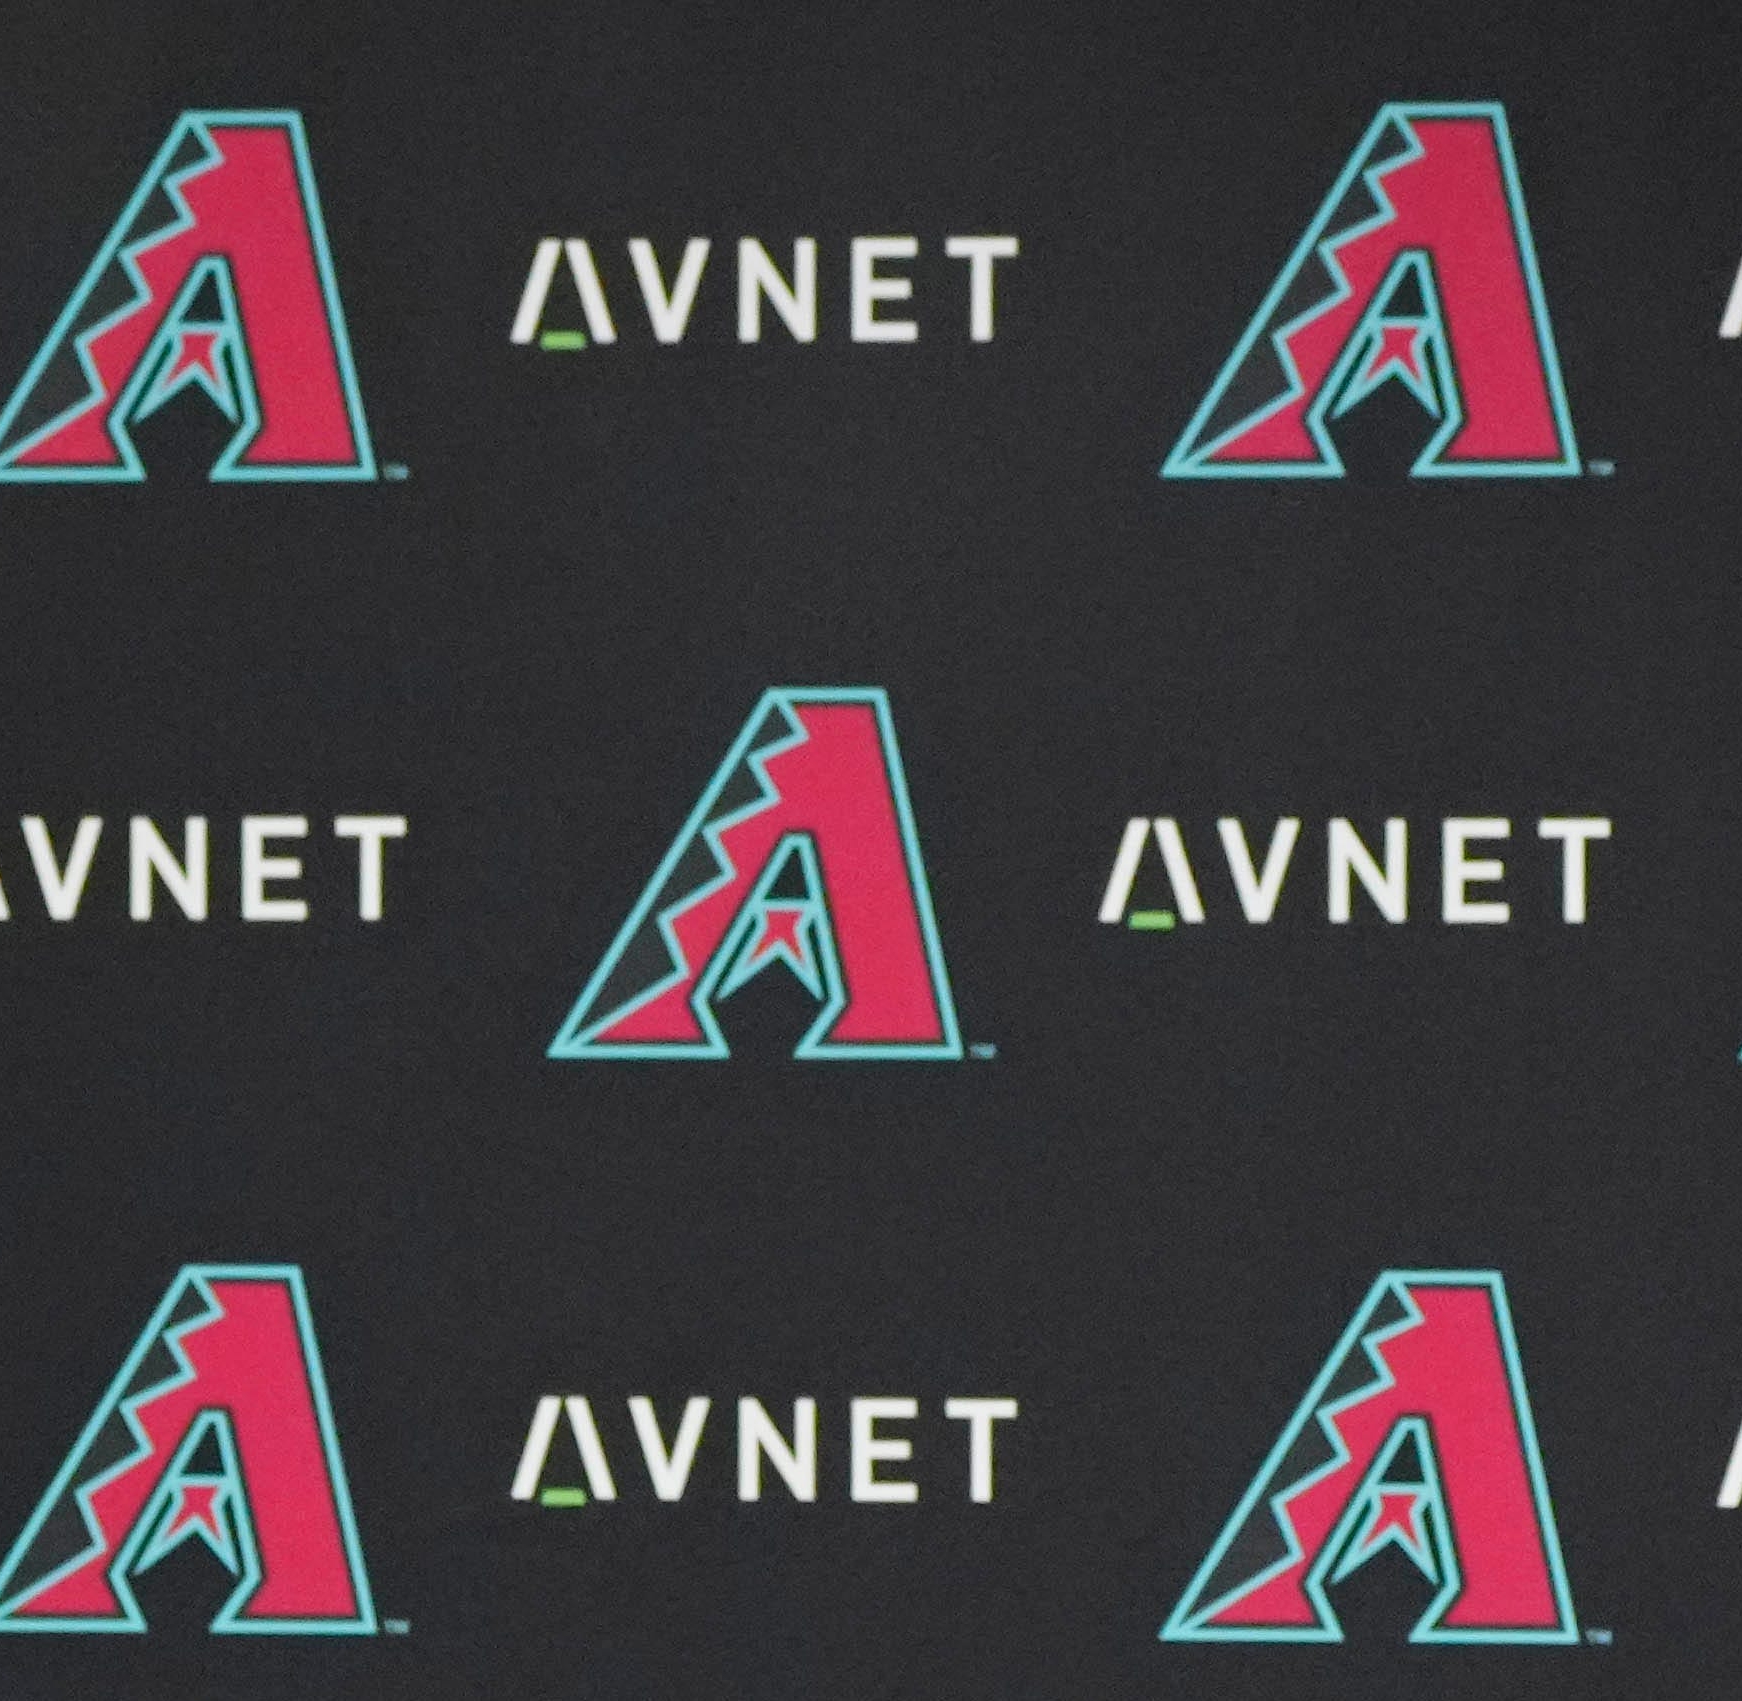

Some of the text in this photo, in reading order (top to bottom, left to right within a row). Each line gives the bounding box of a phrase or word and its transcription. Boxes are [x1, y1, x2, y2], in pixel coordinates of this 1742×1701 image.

[510, 236, 1019, 351] AVNET
[1098, 816, 1612, 931] AVNET
[510, 1395, 1019, 1507] AVNET
